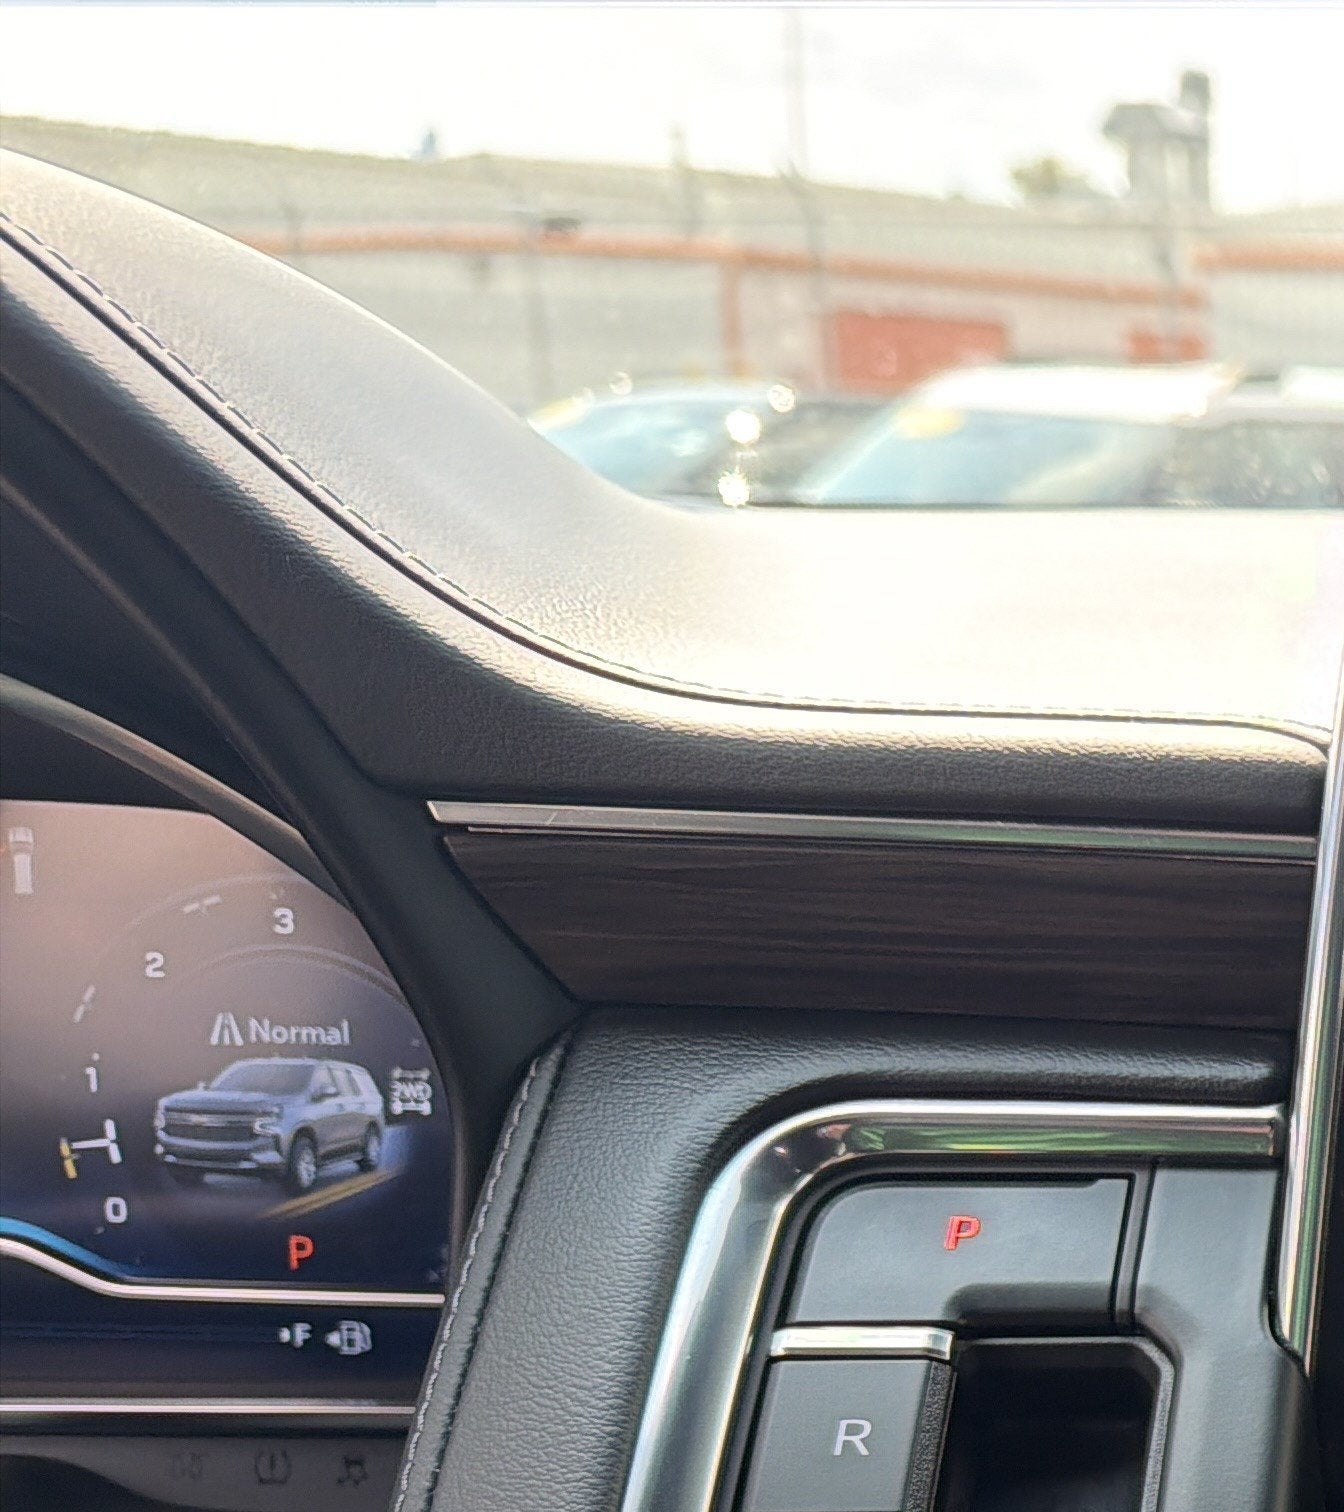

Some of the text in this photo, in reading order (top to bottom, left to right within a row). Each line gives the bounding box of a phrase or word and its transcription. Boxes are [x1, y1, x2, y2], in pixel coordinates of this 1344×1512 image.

[272, 907, 295, 935] 3
[145, 952, 166, 978] 2
[249, 1016, 351, 1045] Normal
[85, 1066, 98, 1093] 1
[103, 1196, 128, 1224] 0
[944, 1215, 981, 1251] P
[289, 1235, 314, 1269] P
[833, 1419, 872, 1456] R
